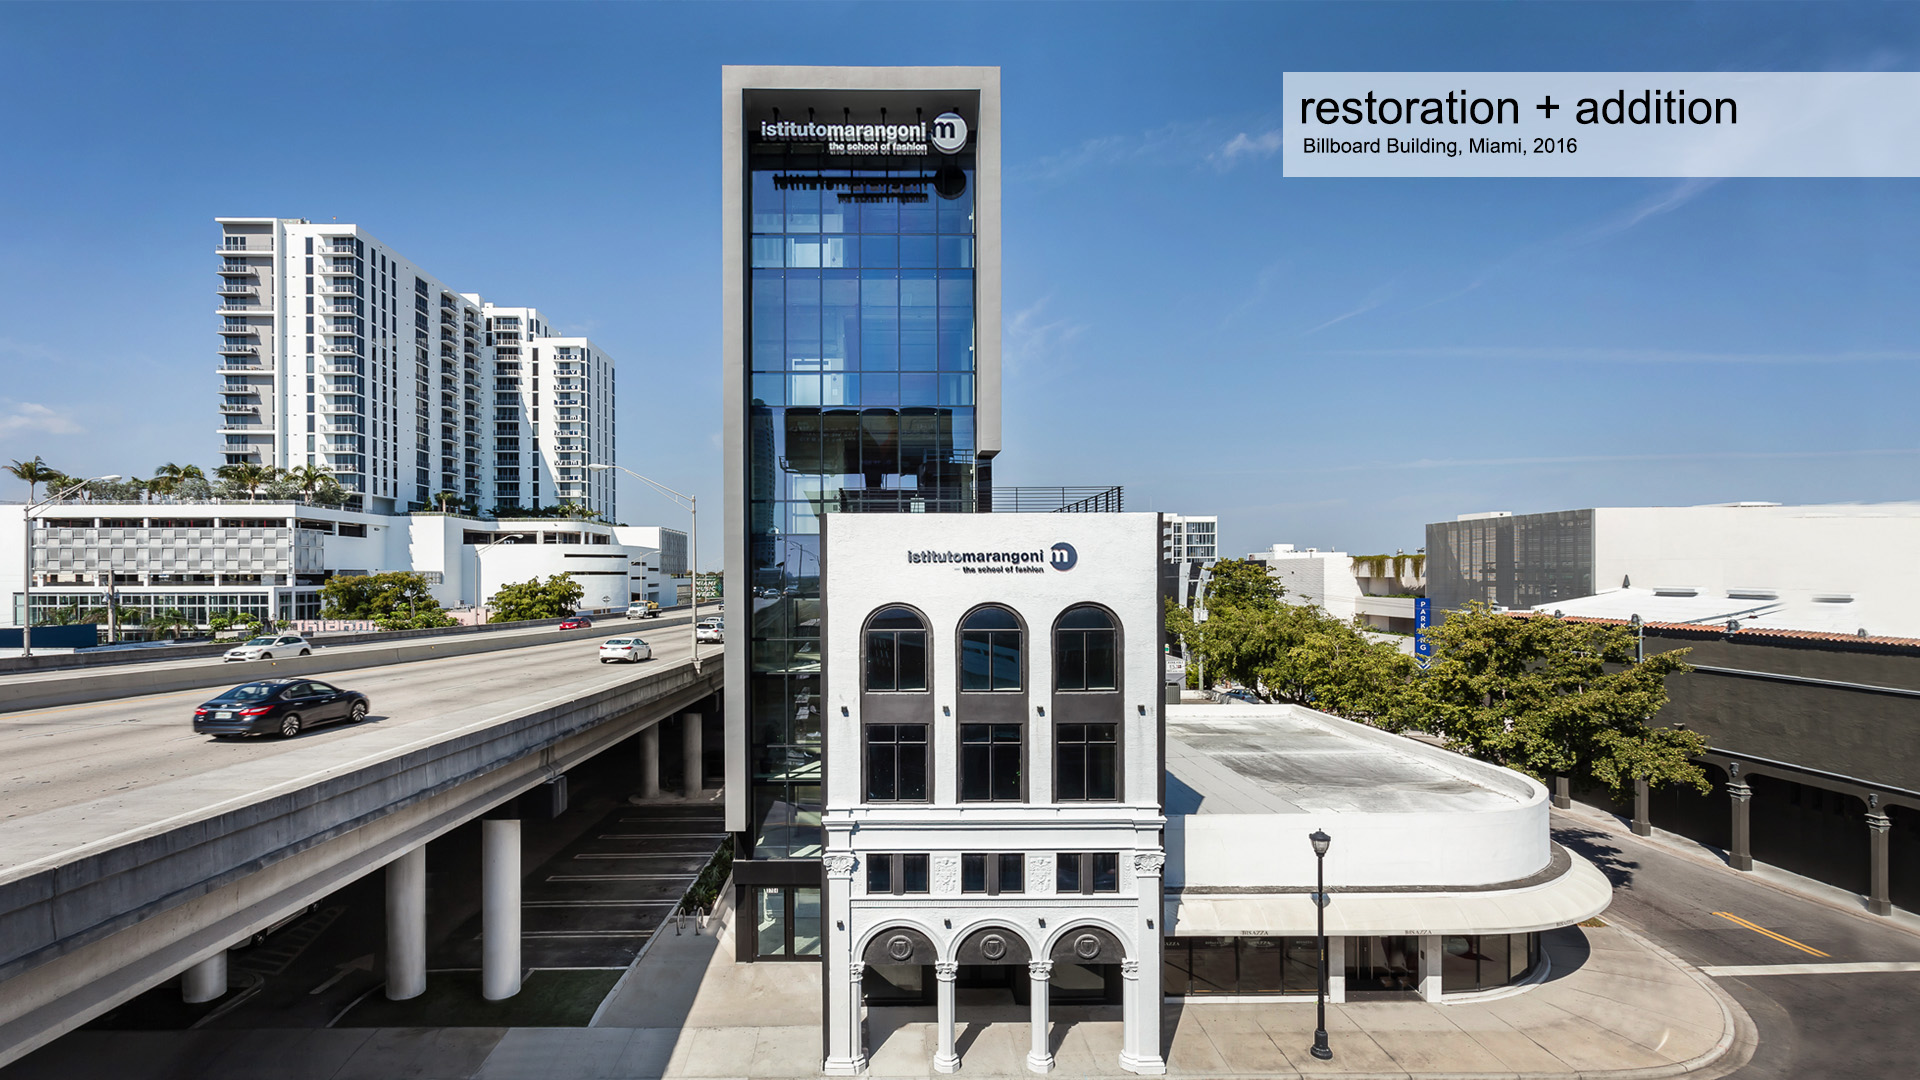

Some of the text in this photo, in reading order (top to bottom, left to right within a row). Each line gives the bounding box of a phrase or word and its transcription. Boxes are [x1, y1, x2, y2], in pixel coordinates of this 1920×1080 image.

[761, 121, 926, 144] istitutomarangoni
[829, 142, 928, 151] the school of fashion
[907, 549, 1044, 567] istitutomarangoni
[963, 566, 1045, 574] the school of fashion
[1419, 601, 1427, 651] PARKNG
